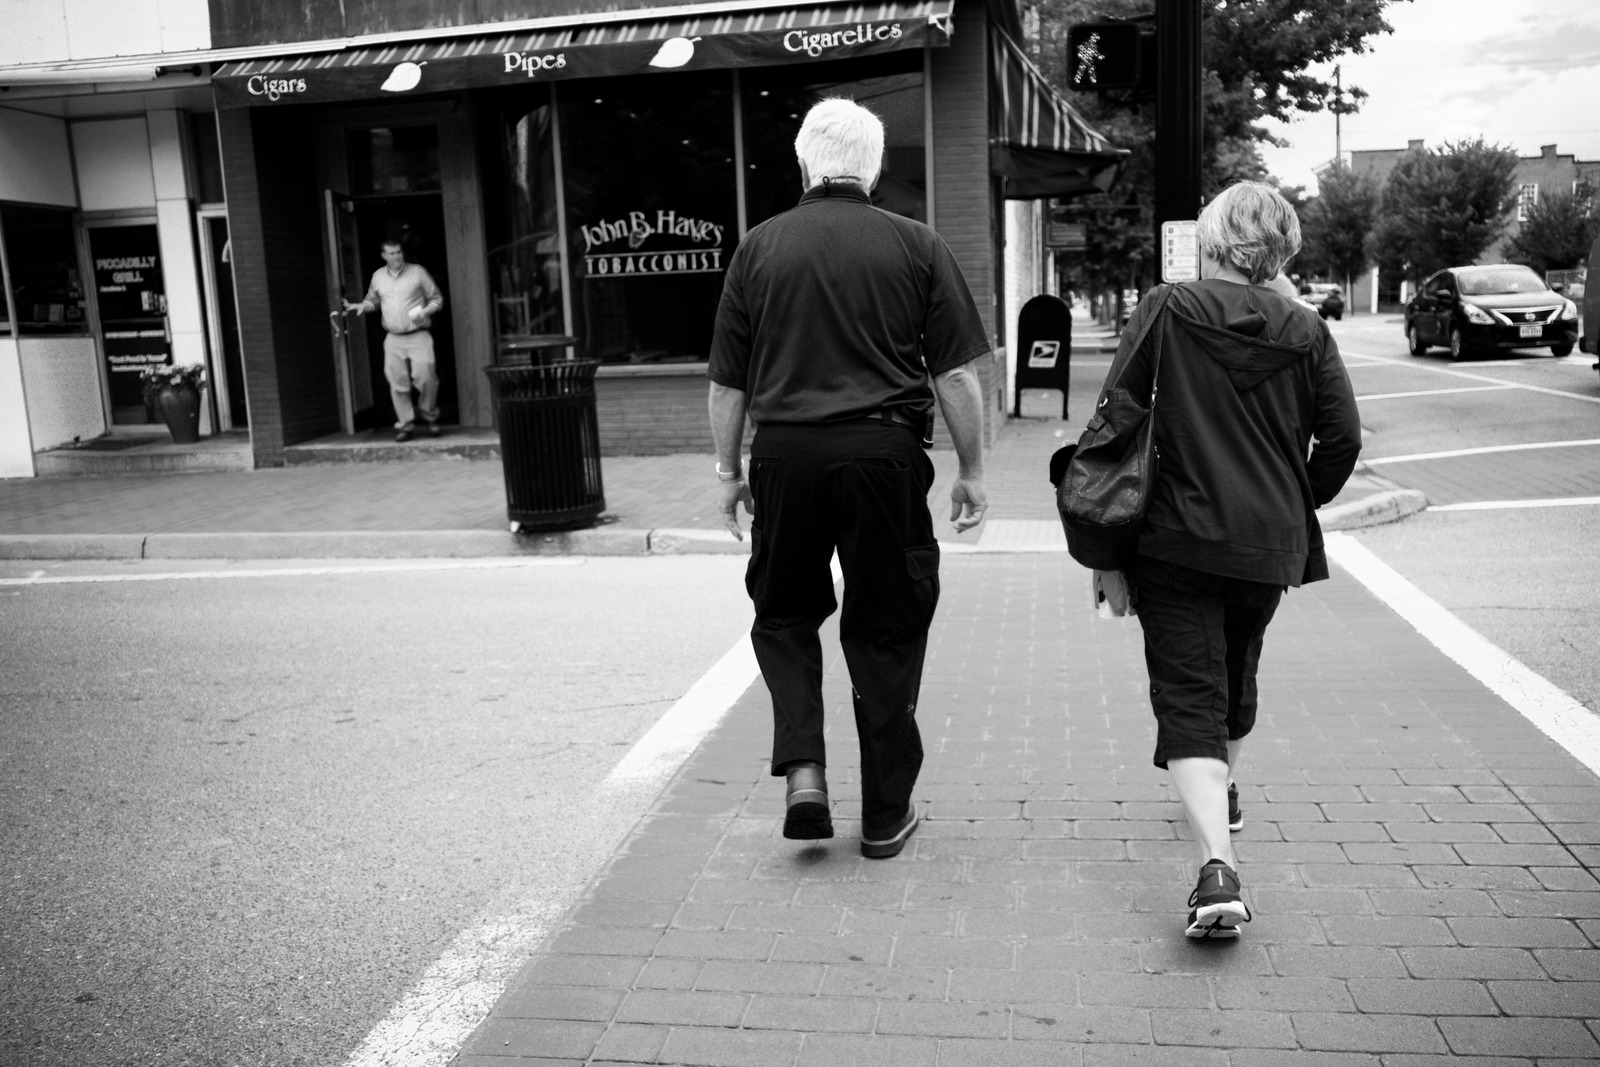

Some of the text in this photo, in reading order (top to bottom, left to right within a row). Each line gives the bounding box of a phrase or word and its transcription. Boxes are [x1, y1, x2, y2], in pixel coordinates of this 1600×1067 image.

[247, 22, 903, 101] Cigars Pipes Cigarettes
[580, 218, 629, 253] John
[656, 209, 724, 248] Hayes
[96, 255, 156, 271] PICCADILLY
[585, 252, 722, 275] TOBACCONIST
[112, 270, 144, 284] GRILL
